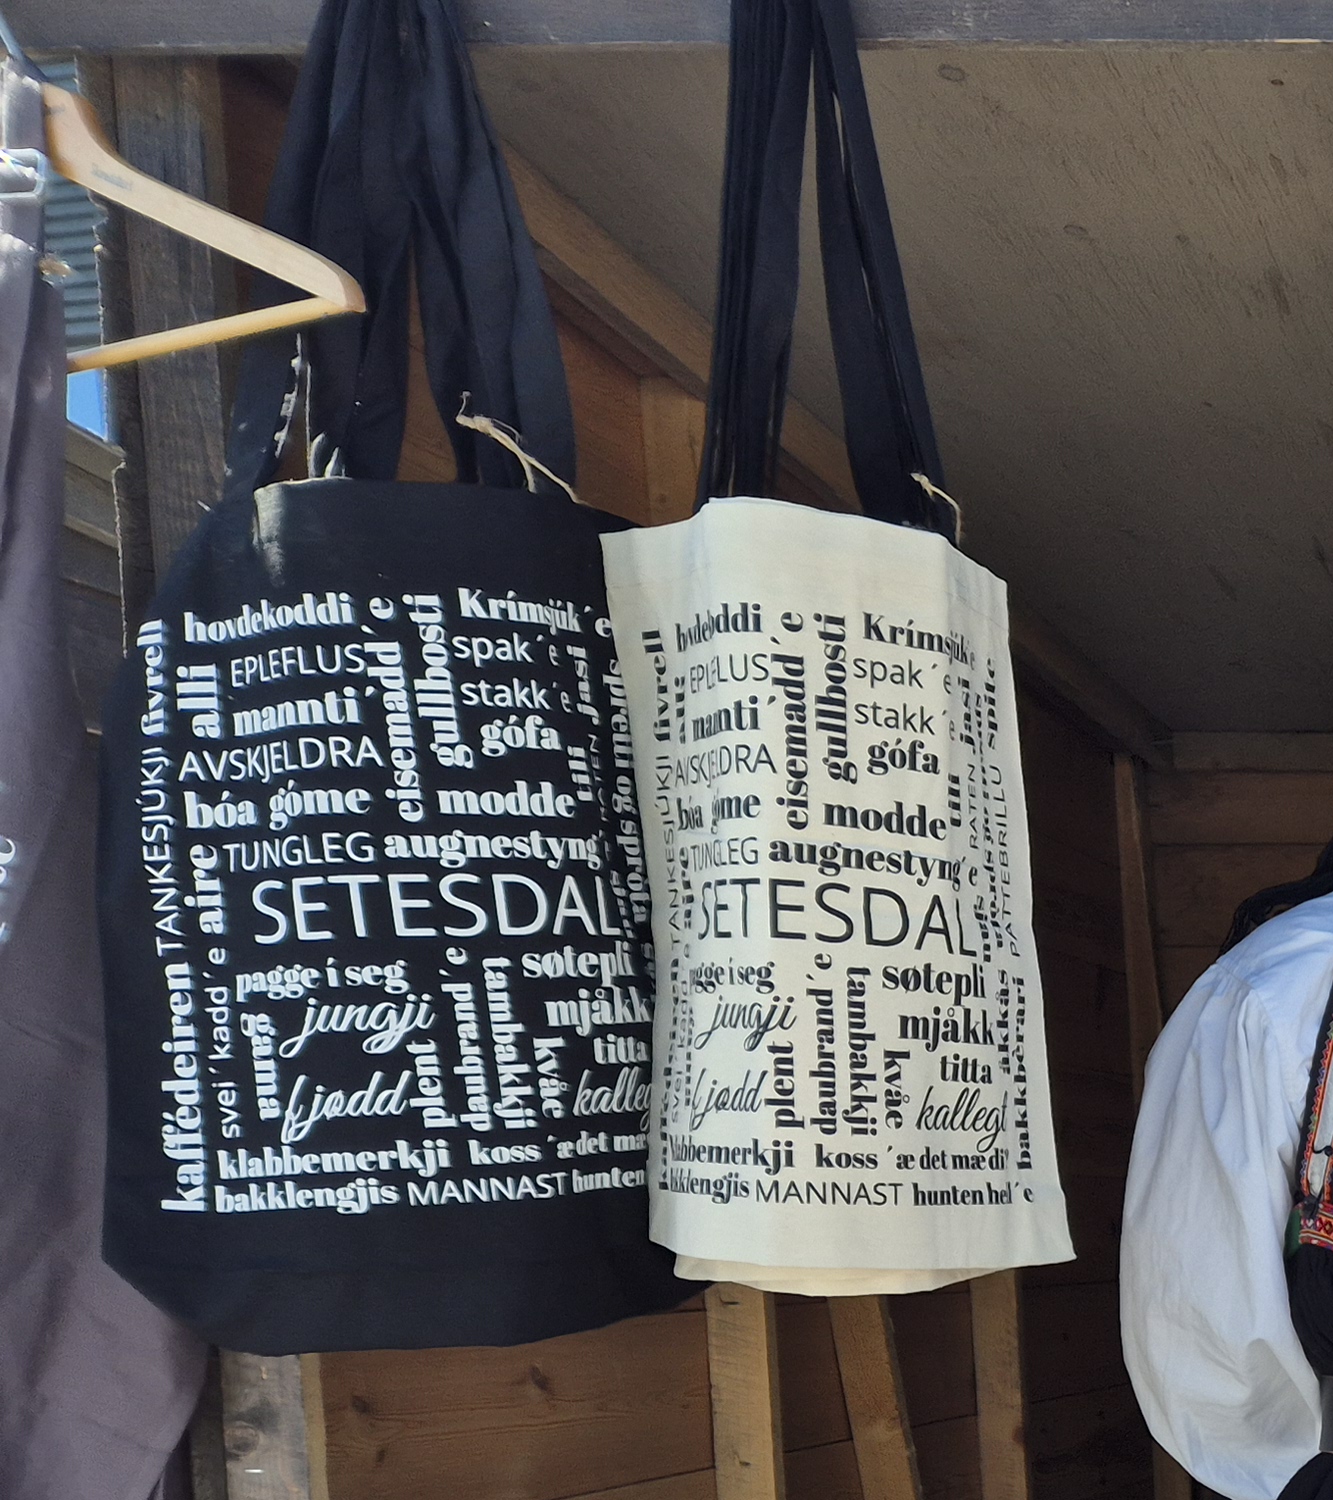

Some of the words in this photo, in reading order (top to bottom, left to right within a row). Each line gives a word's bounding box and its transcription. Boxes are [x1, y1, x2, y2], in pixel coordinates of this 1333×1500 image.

[184, 592, 354, 643] hovdekoddi
[230, 643, 367, 688] EPLEFLUS
[402, 592, 475, 769] gullbosti
[813, 613, 859, 785] gullbosti
[480, 714, 562, 758] gófa
[867, 739, 941, 776] gófa
[178, 735, 384, 783] AVSKJELDRA
[184, 789, 258, 831] bóa
[269, 780, 371, 832] góme
[437, 780, 579, 820] modde
[823, 801, 948, 841] modde
[222, 831, 375, 873] TUNGLEG
[252, 871, 622, 943] SETESDAL
[697, 877, 977, 958] SETESDAL
[521, 941, 636, 987] søtepli
[881, 962, 986, 1006] søtepli
[899, 1005, 994, 1052] mjåkk
[407, 1038, 457, 1129] plent
[763, 1041, 806, 1130] plent
[939, 1052, 992, 1085] titta
[217, 1138, 453, 1180] klabbemerkji
[468, 1139, 541, 1167] koss
[815, 1143, 878, 1170] koss
[214, 1178, 399, 1214] bakklengjis
[407, 1172, 569, 1207] MANNAST
[755, 1181, 904, 1207] MANNAST
